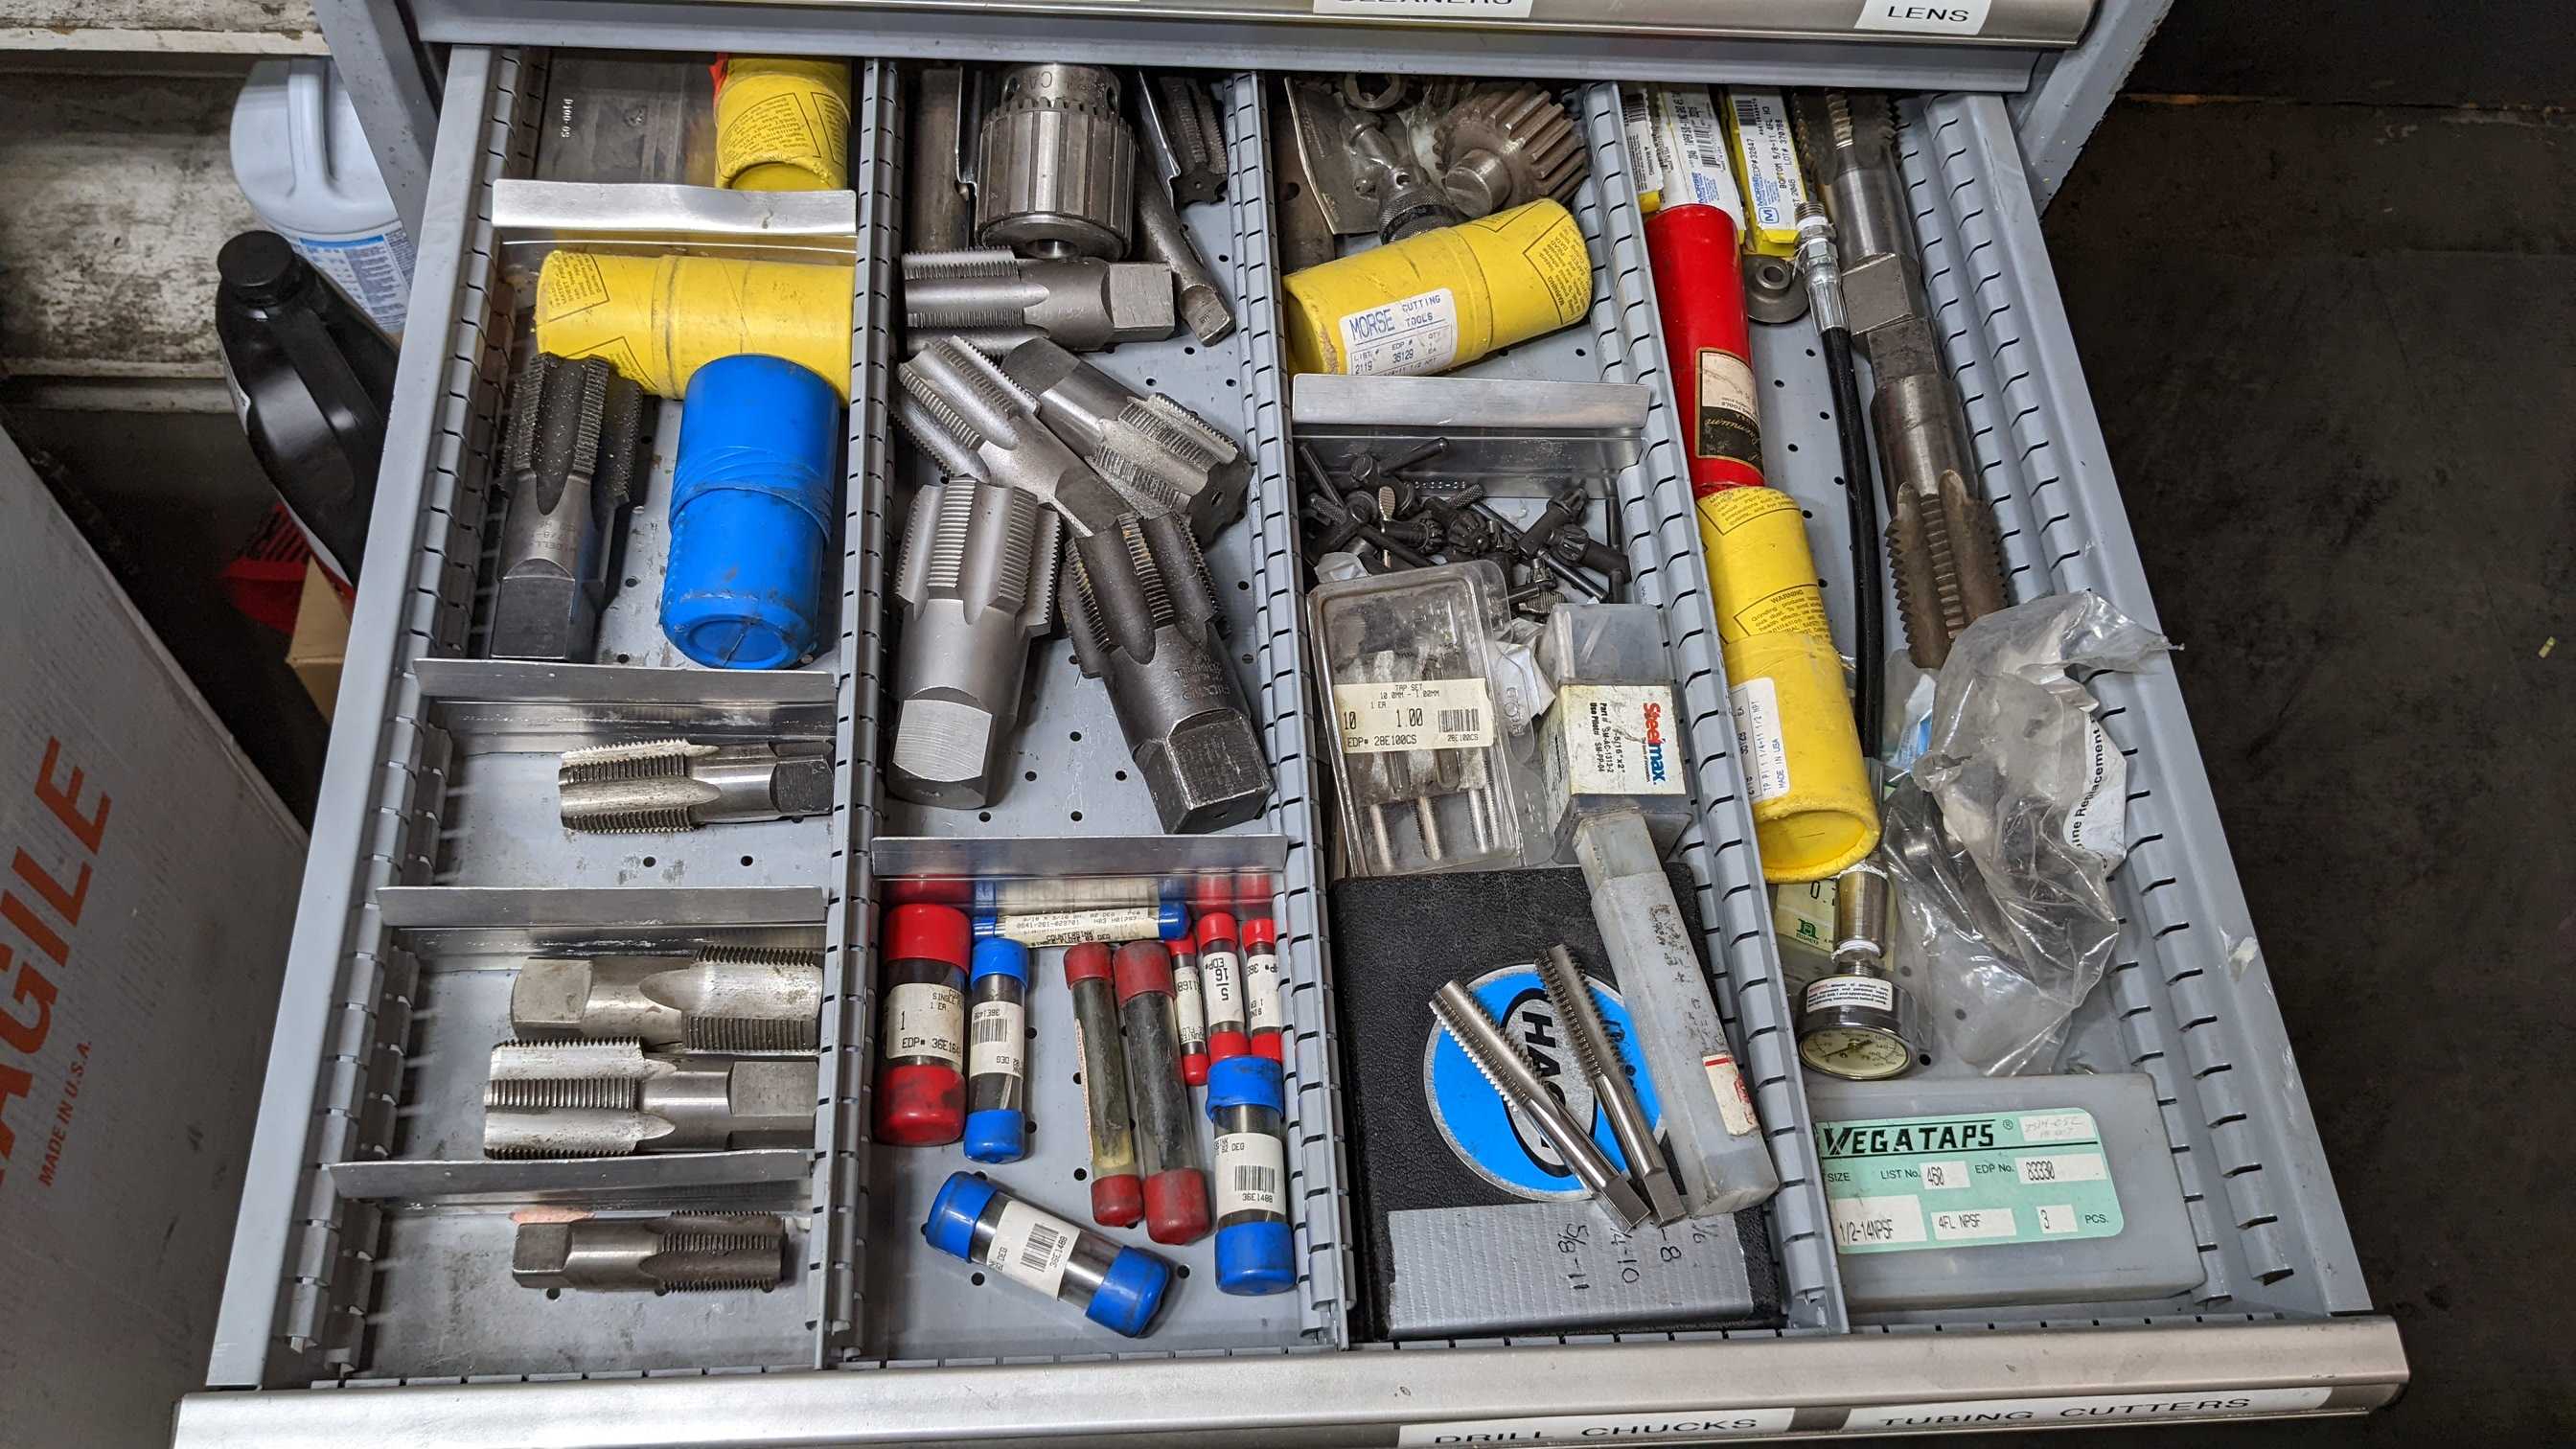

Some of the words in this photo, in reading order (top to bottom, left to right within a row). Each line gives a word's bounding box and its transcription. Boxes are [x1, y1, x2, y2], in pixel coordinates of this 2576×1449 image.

[1887, 6, 1969, 22] LENS
[1749, 176, 1763, 207] MORSE
[1400, 293, 1441, 313] CUTTING
[1347, 308, 1396, 341] MORSE
[1404, 310, 1435, 328] TOOLS
[1390, 340, 1406, 351] EDP
[1769, 588, 1805, 604] WARNING
[1394, 683, 1408, 692] TAP
[1411, 682, 1423, 691] SET
[1588, 702, 1598, 717] Use
[1598, 702, 1608, 719] Part
[1343, 710, 1357, 730] 10
[1372, 732, 1417, 747] 28E100CS
[1643, 702, 1667, 783] Steelmax
[1772, 737, 1781, 751] USA
[1776, 769, 1785, 788] MADE
[1215, 967, 1228, 981] 16
[899, 1010, 906, 1030] 1
[995, 1054, 1010, 1064] DEG
[37, 1124, 68, 1188] MADE
[56, 1098, 75, 1125] IN
[1230, 1141, 1245, 1152] DEG
[1824, 1119, 1995, 1156] VEGATAPS
[1827, 1170, 1851, 1184] SIZE
[1879, 1167, 1904, 1180] LIST
[1904, 1167, 1920, 1179] No.
[1974, 1162, 1995, 1175] EDP
[1997, 1162, 2014, 1174] No.
[1838, 1217, 1894, 1243] 1/2-14NPSF
[1938, 1214, 1956, 1230] 4FL
[1959, 1211, 1981, 1230] NPSF
[2039, 1208, 2049, 1230] 3
[2084, 1212, 2109, 1225] PCS.
[996, 1246, 1008, 1261] DEG
[1557, 1223, 1589, 1290] 5/8-11
[1880, 1411, 2034, 1427] TUBING
[2059, 1398, 2251, 1418] CUTTERS
[1435, 1431, 1554, 1443] DRILL
[1580, 1417, 1757, 1438] CHUCKS
